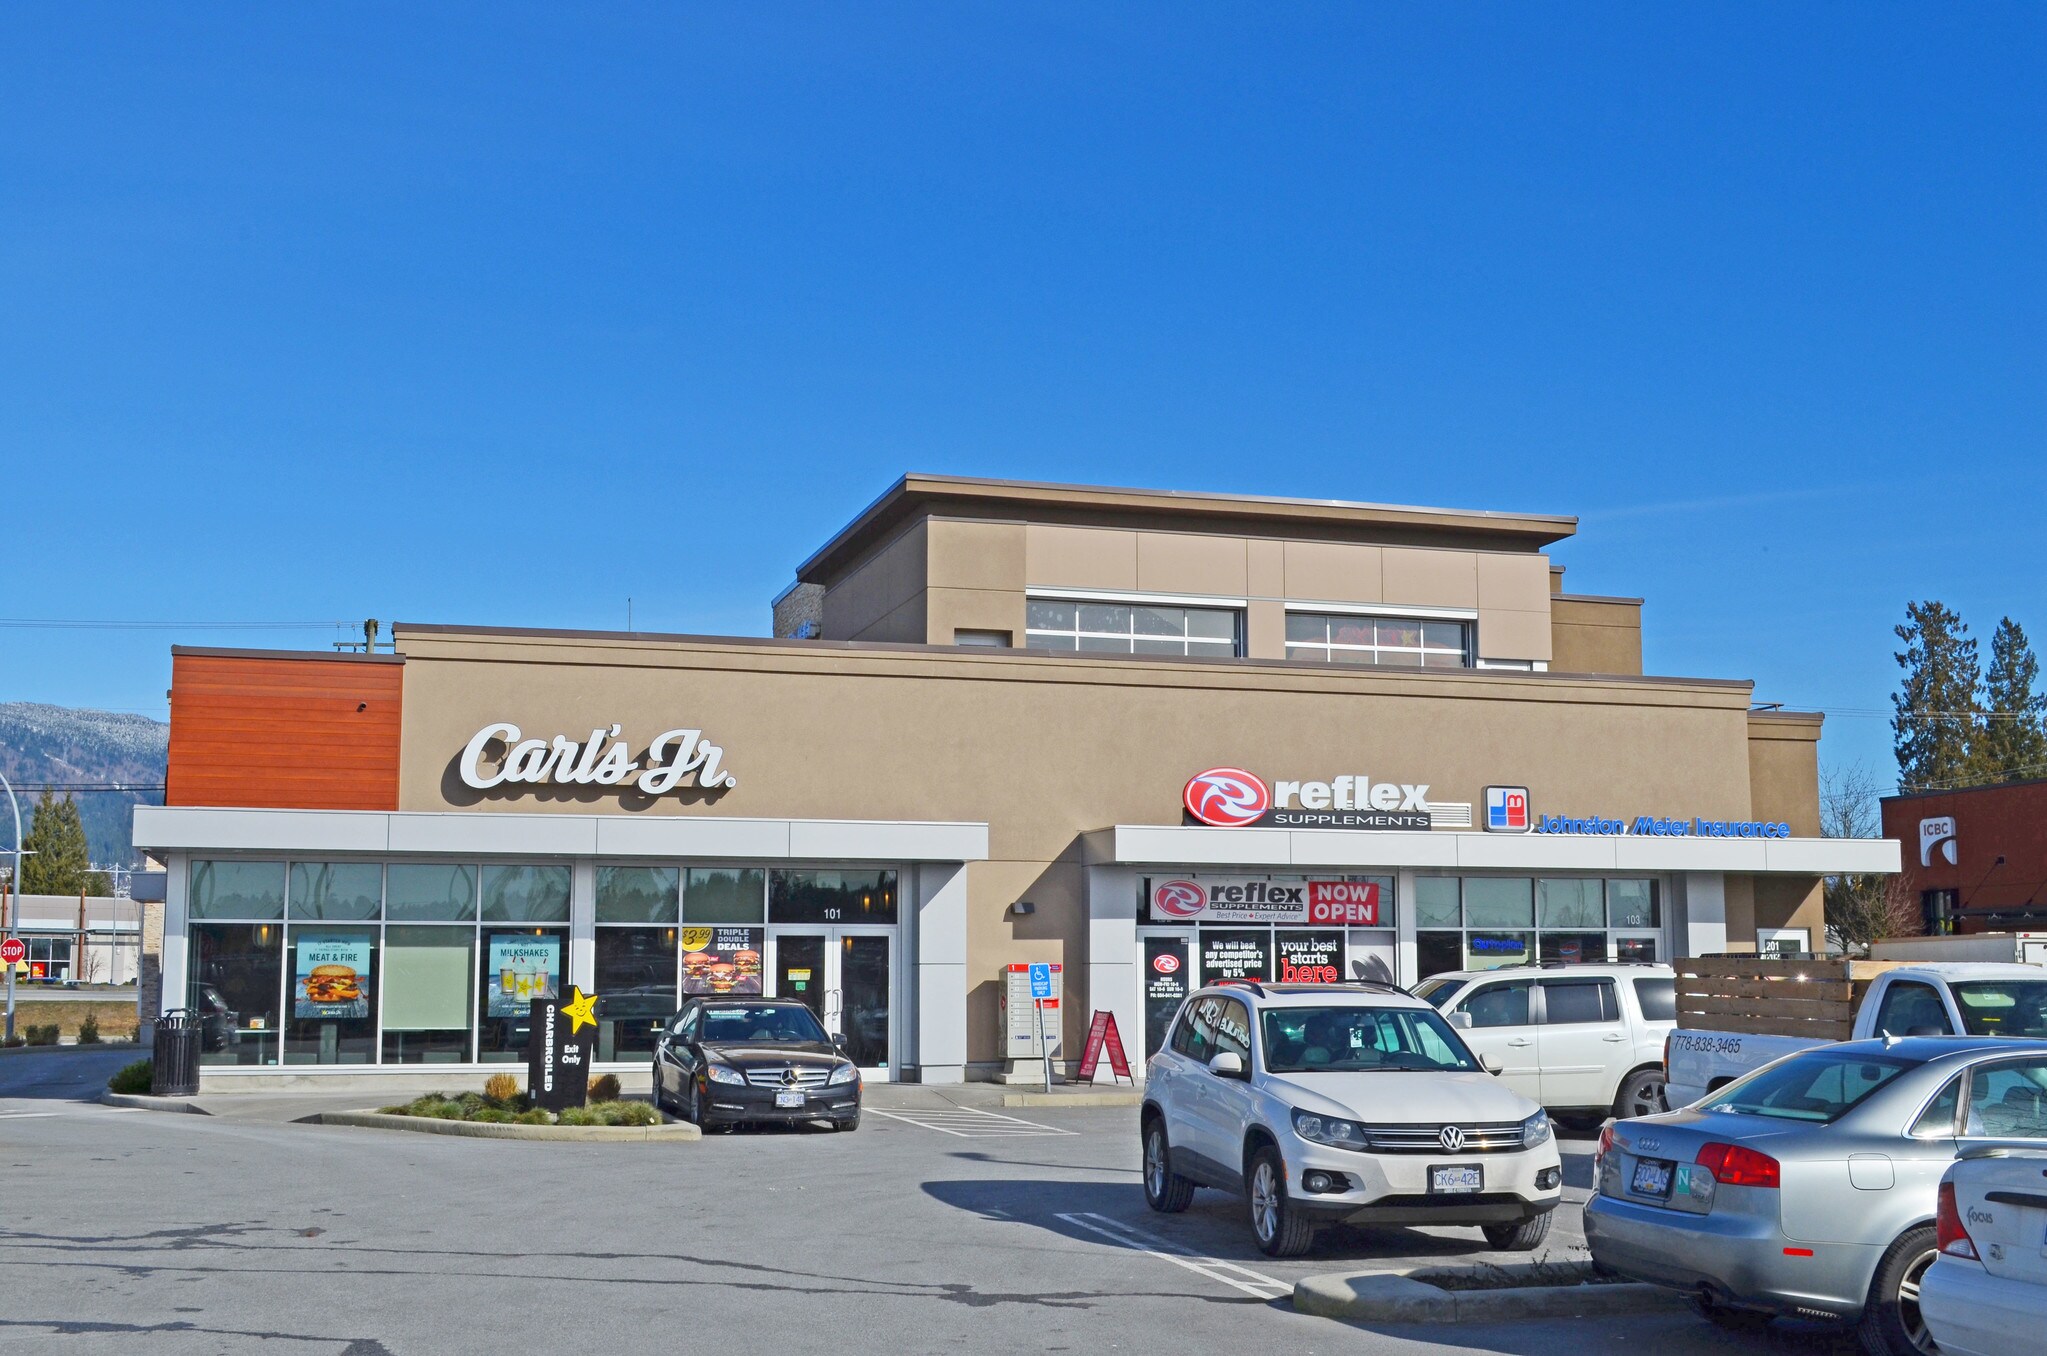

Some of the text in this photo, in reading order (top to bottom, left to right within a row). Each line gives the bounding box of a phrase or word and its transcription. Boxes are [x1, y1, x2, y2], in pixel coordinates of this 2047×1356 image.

[459, 722, 638, 789] Carl's
[1274, 775, 1430, 812] reflex
[1274, 813, 1428, 827] SUPPLEMENTS
[1537, 812, 1791, 838] Johnston Meier Insurance
[1923, 823, 1949, 836] ICBC
[1210, 882, 1303, 903] reflex
[1317, 884, 1370, 902] NOW
[1211, 902, 1303, 911] SUPPLEMENTS
[1313, 903, 1372, 921] OPEN
[824, 908, 841, 920] 101
[1216, 911, 1231, 919] Best
[1232, 911, 1248, 919] Price
[1626, 914, 1641, 925] 103
[682, 928, 711, 946] $3.99
[717, 928, 750, 936] TRIPLE
[2, 946, 23, 957] STOP
[717, 943, 750, 951] DEALS
[1212, 941, 1256, 950] We will beat
[1281, 938, 1337, 955] your best
[1766, 941, 1780, 951] 201
[309, 953, 358, 961] MEAT & FIRE
[500, 948, 549, 957] MILKSHAKES
[1205, 950, 1263, 960] any competitor's
[1290, 952, 1329, 964] starts
[1206, 960, 1263, 969] advertised price
[1280, 957, 1338, 983] here
[1223, 968, 1246, 977] by 5%
[544, 1004, 555, 1092] CHARBROILED
[564, 1045, 580, 1054] Exit
[1674, 1035, 1742, 1054] 778-838-3465
[561, 1055, 582, 1065] Only
[1678, 1169, 1689, 1185] N
